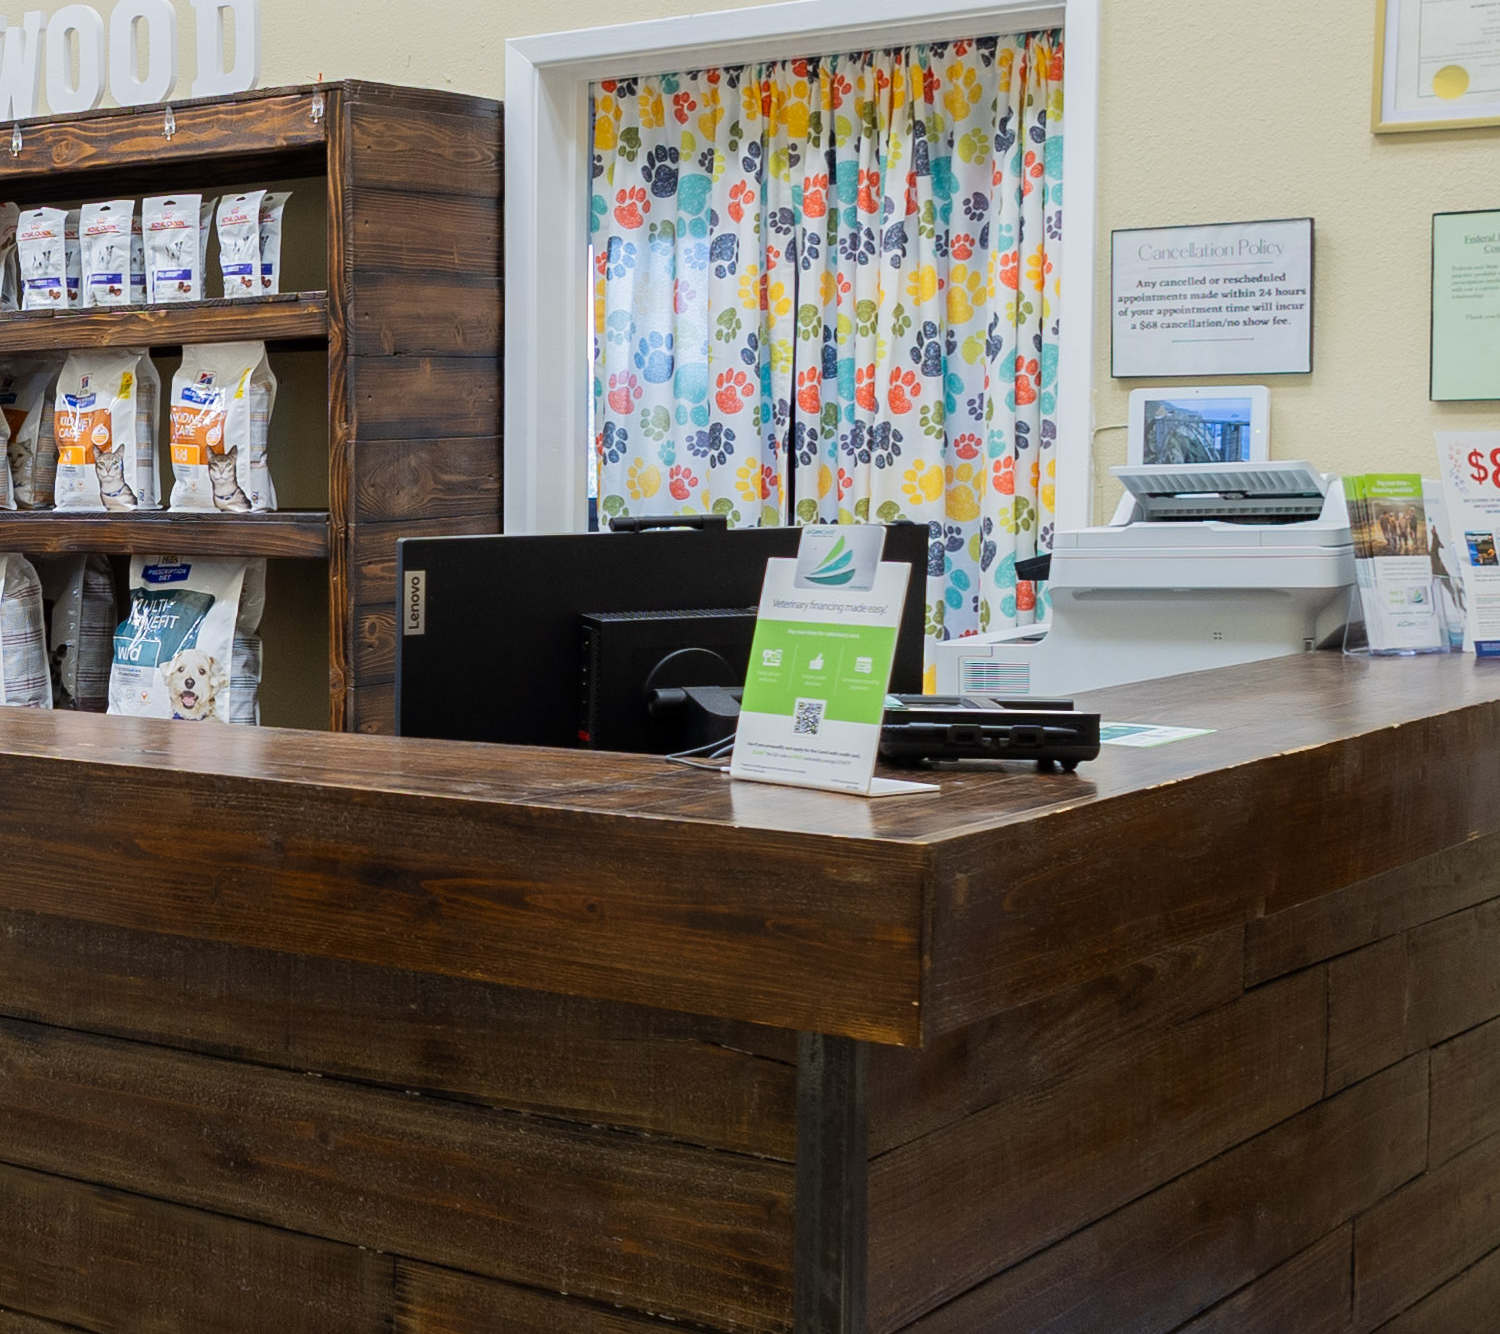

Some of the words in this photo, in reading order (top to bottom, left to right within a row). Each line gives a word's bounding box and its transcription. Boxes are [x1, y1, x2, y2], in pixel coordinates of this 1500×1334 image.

[1464, 234, 1495, 244] Federal
[1138, 242, 1234, 261] Cancellation
[1238, 238, 1285, 257] Policy
[1136, 279, 1157, 289] Any
[1159, 276, 1206, 287] cancelled
[1210, 277, 1220, 285] or
[1223, 273, 1286, 284] rescheduled
[1117, 293, 1187, 303] appointments
[1190, 291, 1218, 300] made
[1221, 289, 1255, 298] within
[1259, 288, 1272, 297] 24
[1275, 286, 1306, 296] hours
[1118, 308, 1128, 316] of
[1131, 308, 1154, 318] your
[1157, 306, 1223, 316] appointment
[1226, 304, 1250, 312] time
[1252, 303, 1272, 311] will
[1276, 302, 1305, 310] incur
[1140, 321, 1158, 330] $68
[1160, 318, 1240, 329] cancellation/no
[1242, 317, 1269, 326] show
[1273, 316, 1291, 325] fee.
[408, 576, 420, 629] Lenovo
[772, 598, 809, 611] Veterinary
[810, 600, 844, 614] financing
[845, 604, 867, 613] made
[117, 644, 142, 662] w/d
